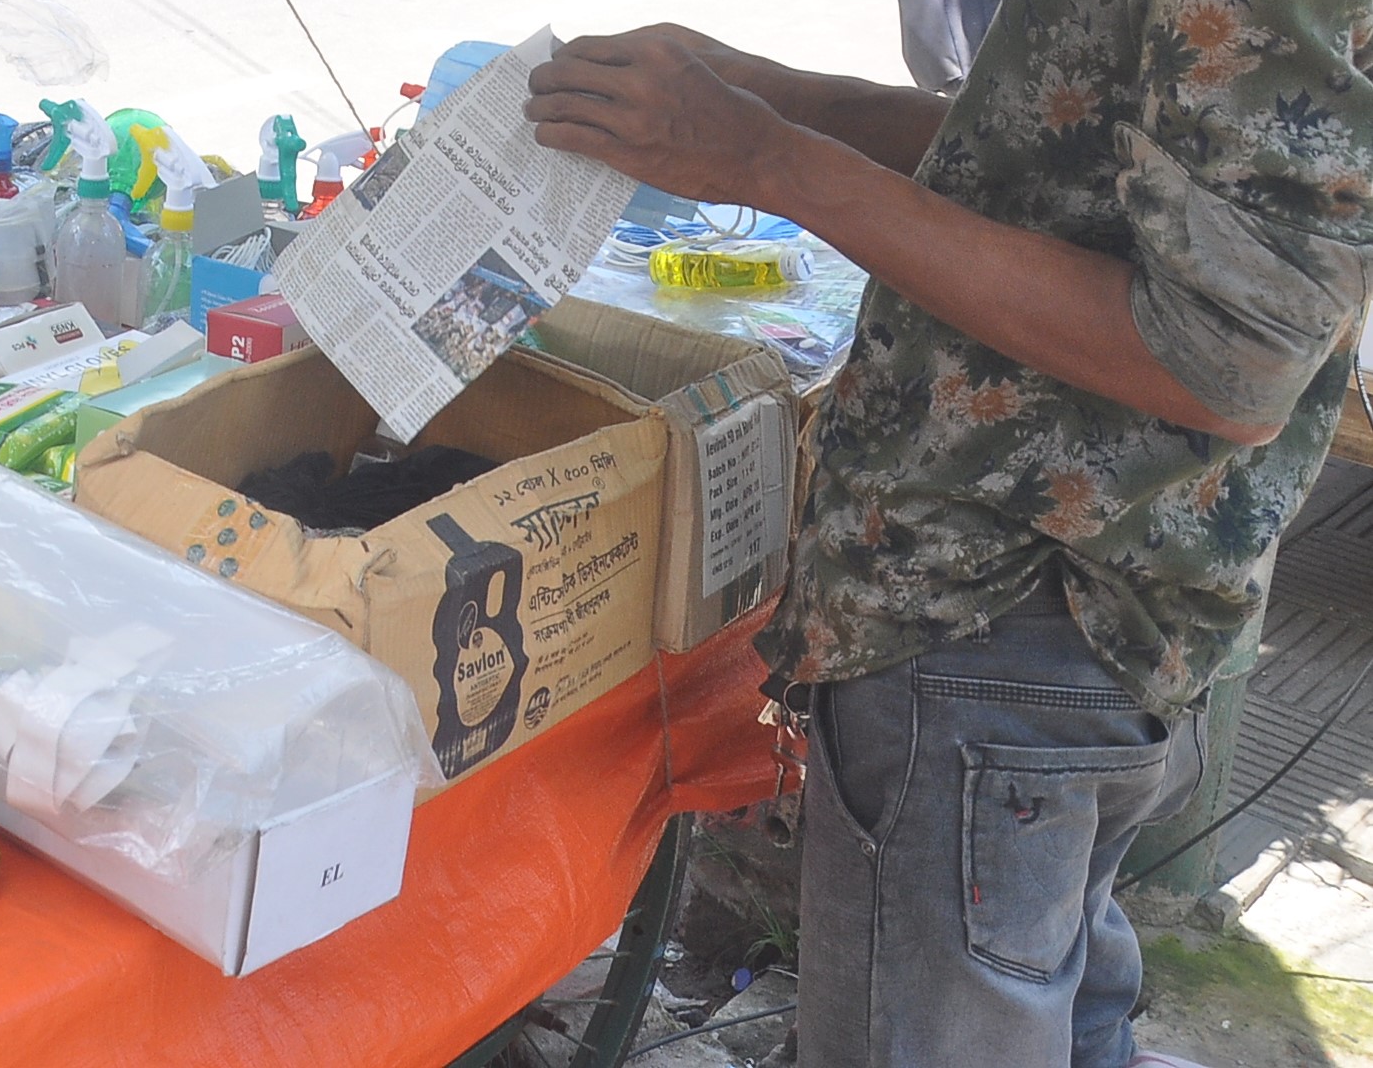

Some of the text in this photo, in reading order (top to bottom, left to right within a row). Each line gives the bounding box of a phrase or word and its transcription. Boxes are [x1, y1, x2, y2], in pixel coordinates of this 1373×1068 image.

[50, 320, 76, 333] KN95
[494, 488, 516, 507] ১২
[563, 463, 590, 481] ৫০০
[590, 451, 618, 475] মিলি
[708, 483, 724, 501] Pack
[457, 648, 507, 683] Savlon
[320, 862, 344, 889] EL
